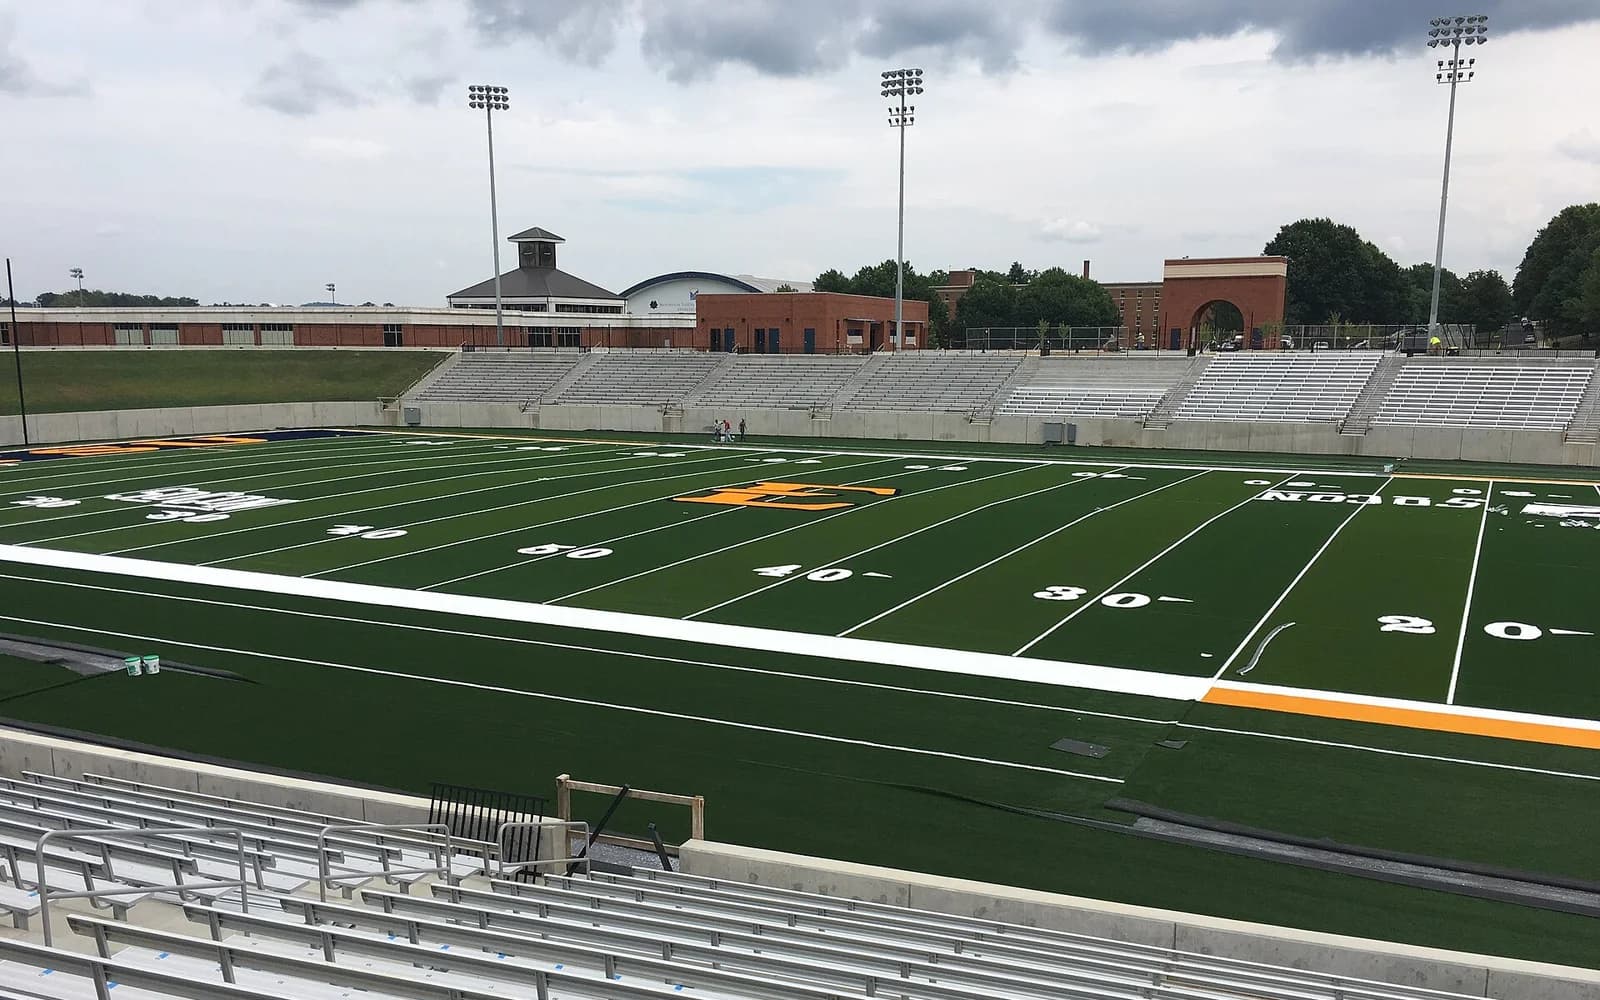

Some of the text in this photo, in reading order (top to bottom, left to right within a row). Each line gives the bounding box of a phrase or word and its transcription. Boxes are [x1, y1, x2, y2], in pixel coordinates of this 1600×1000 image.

[516, 543, 614, 559] 50
[752, 564, 853, 582] 40
[1033, 585, 1152, 608] 30
[1377, 615, 1543, 640] 20
